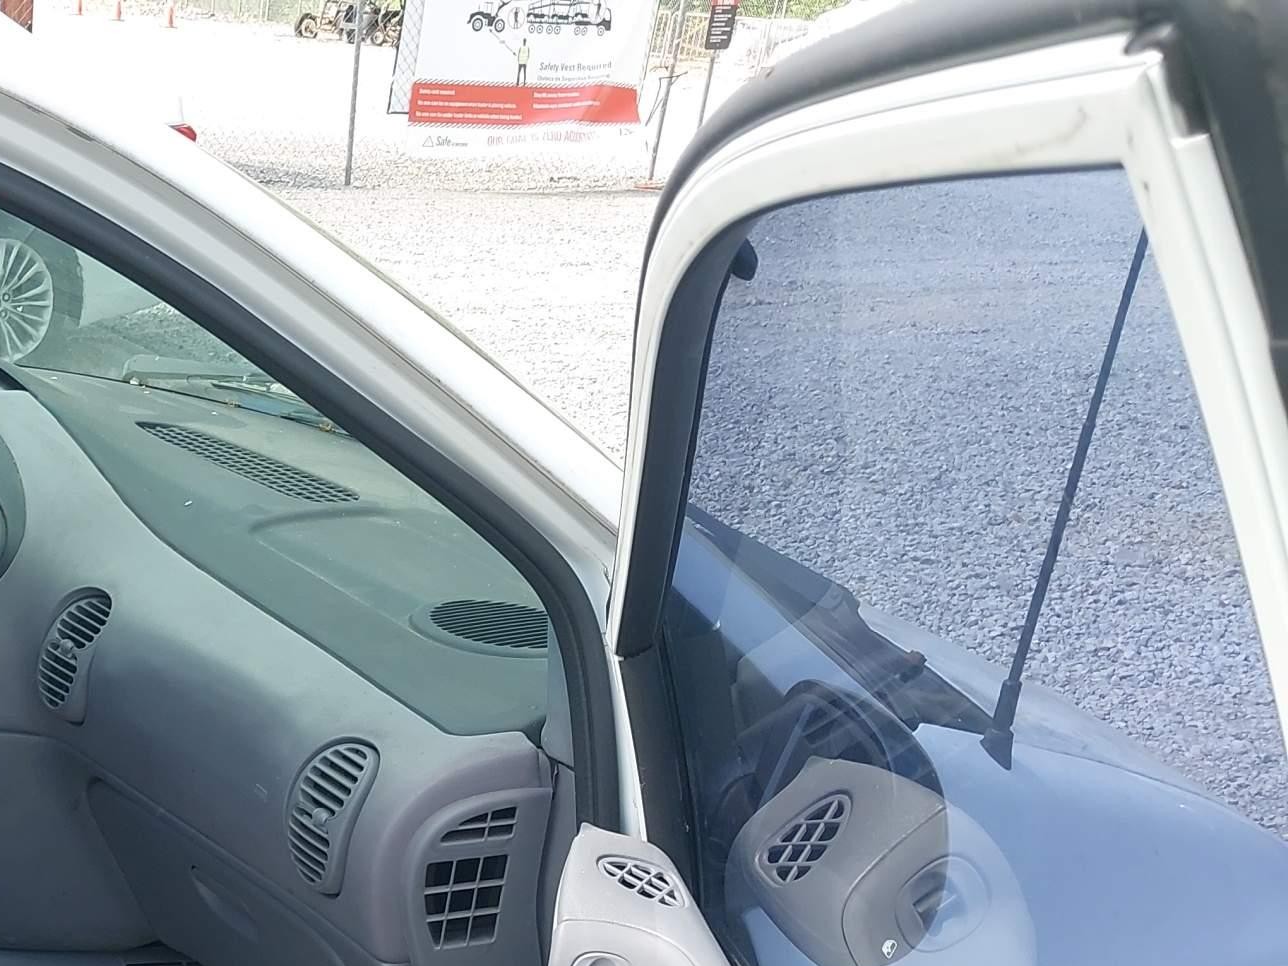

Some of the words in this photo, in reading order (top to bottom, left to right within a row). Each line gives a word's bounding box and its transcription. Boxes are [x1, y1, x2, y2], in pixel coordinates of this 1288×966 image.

[539, 62, 559, 72] Safety
[560, 62, 575, 72] Vest
[435, 135, 452, 147] Safe
